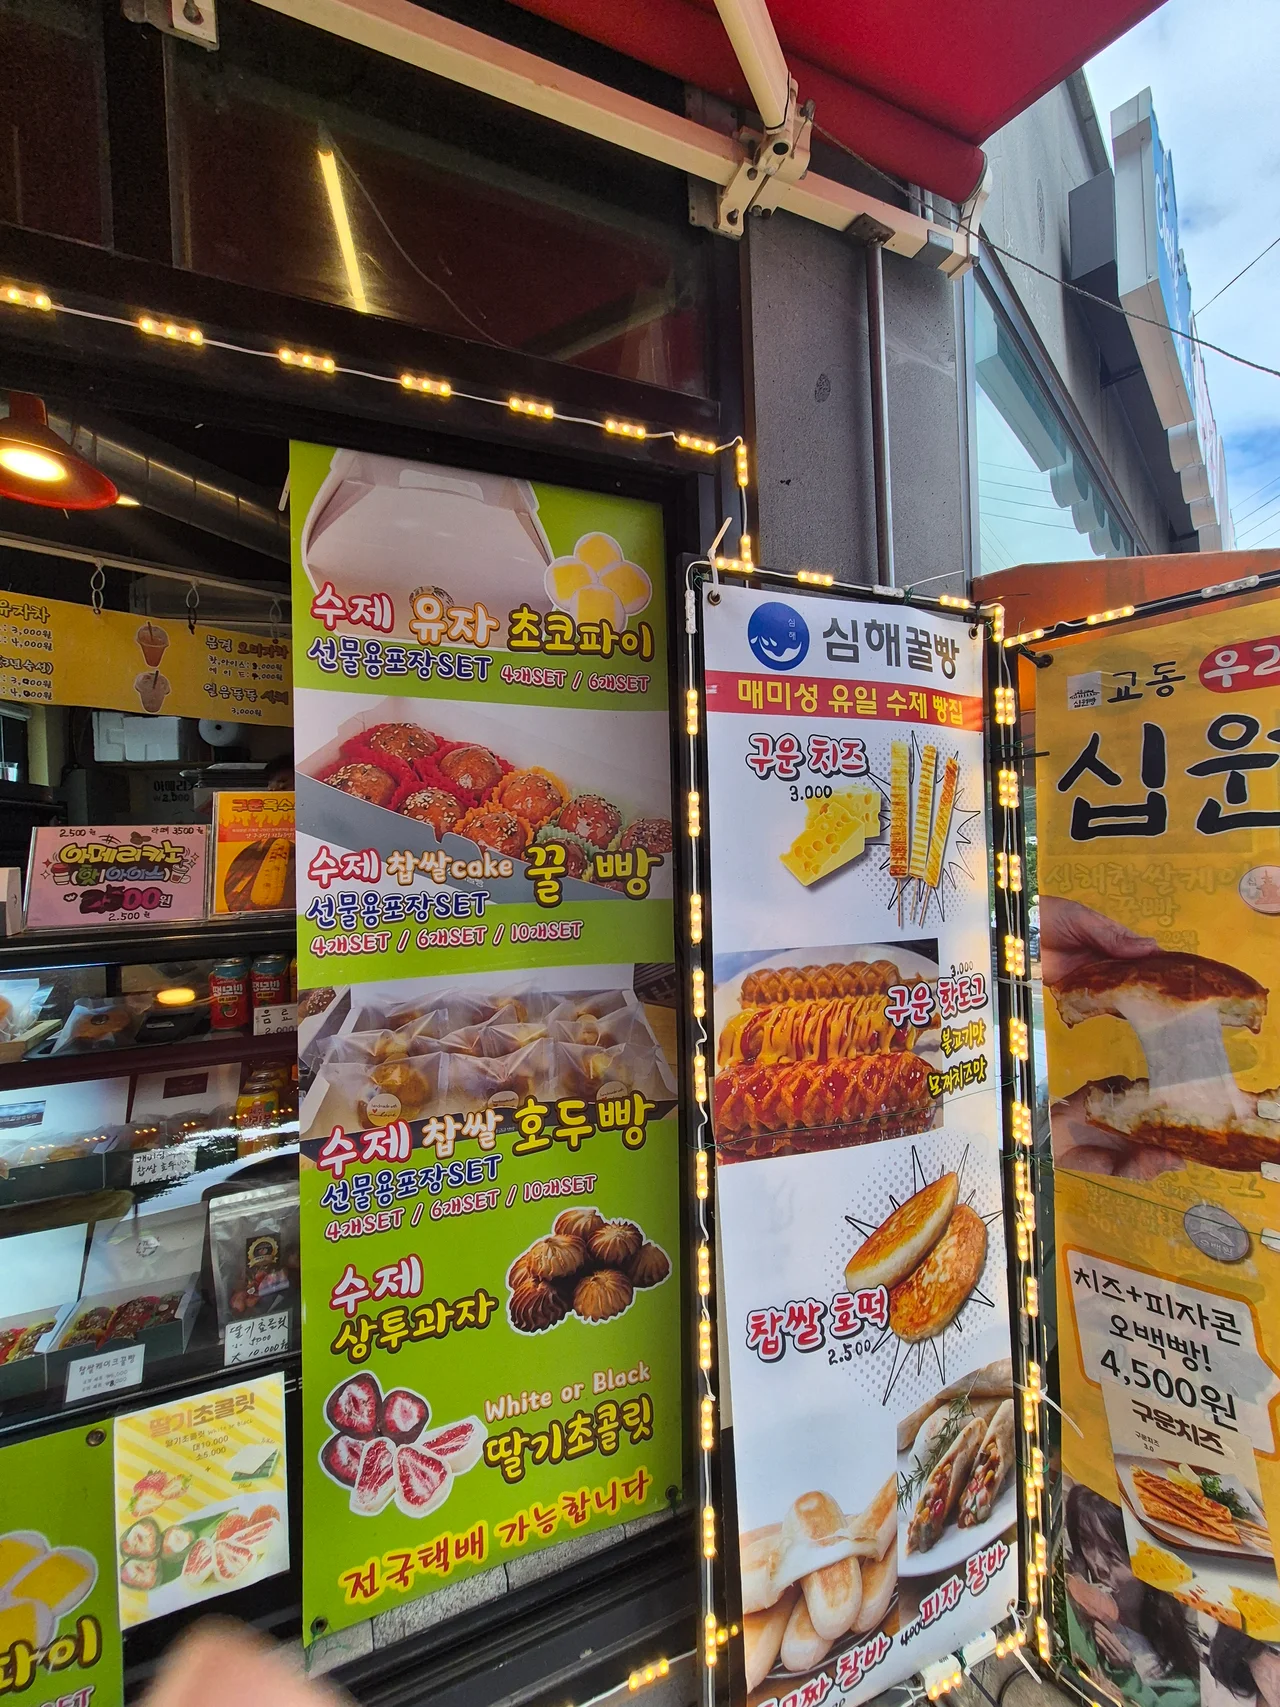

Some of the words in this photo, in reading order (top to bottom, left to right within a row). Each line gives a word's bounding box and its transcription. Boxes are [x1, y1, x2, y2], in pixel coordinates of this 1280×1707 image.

[310, 582, 395, 632] 수제
[409, 593, 500, 647] 유자
[507, 607, 655, 661] 초코파이
[822, 618, 960, 680] 심해꿀빵
[308, 637, 494, 682] 선물용포장SET
[500, 664, 569, 691] 4개SET
[571, 670, 583, 693] /
[587, 671, 652, 694] 6개SET
[1107, 661, 1187, 704] 교동
[737, 679, 818, 713] 매미성
[828, 684, 878, 716] 유일
[886, 689, 928, 720] 수제
[932, 698, 964, 726] 빵집
[746, 733, 805, 781] 구운
[807, 734, 869, 775] 치즈
[789, 785, 832, 802] 3.000
[59, 840, 186, 865] 아메리카노
[307, 845, 382, 890] 수제
[386, 849, 514, 887] 찹쌀cake
[304, 892, 490, 929] 선물용포장SET
[310, 933, 391, 958] 4개SET
[397, 929, 410, 953] /
[415, 926, 489, 949] 6개SET
[492, 924, 506, 947] /
[510, 920, 584, 944] 10개SET
[950, 960, 975, 978] 3.000
[884, 981, 936, 1028] 구운
[937, 973, 989, 1020] 핫도그
[940, 1017, 987, 1059] 불고기맛
[927, 1053, 988, 1100] 모짜치즈맛
[317, 1120, 413, 1179] 수제
[420, 1110, 504, 1160] 찹쌀
[511, 1093, 656, 1157] 호두빵
[321, 1156, 503, 1212] 선물용포장SET
[324, 1209, 404, 1242] 4개SET
[410, 1203, 424, 1226] /
[429, 1191, 500, 1220] 6개SET
[505, 1185, 517, 1208] /
[522, 1175, 597, 1203] 10개SET
[331, 1253, 424, 1316] 수제
[1073, 1266, 1242, 1347] 치즈+피자콘
[331, 1289, 499, 1363] 상투과자
[746, 1298, 829, 1364] 찹쌀
[829, 1284, 891, 1338] 호떡
[828, 1339, 871, 1366] 2.500
[1108, 1314, 1213, 1373] 오백빵!
[149, 1392, 255, 1439] 딸기초콜릿
[484, 1391, 553, 1424] White
[560, 1382, 585, 1403] or
[592, 1361, 651, 1396] Black
[1100, 1348, 1238, 1433] 4,500원
[483, 1393, 654, 1485] 딸기초콜릿
[1131, 1399, 1225, 1456] 구운치즈
[340, 1521, 488, 1605] 전국택배
[499, 1465, 653, 1548] 가능합니다
[919, 1575, 966, 1626] 피자
[964, 1540, 1010, 1597] 찰바
[835, 1631, 893, 1692] 찰바
